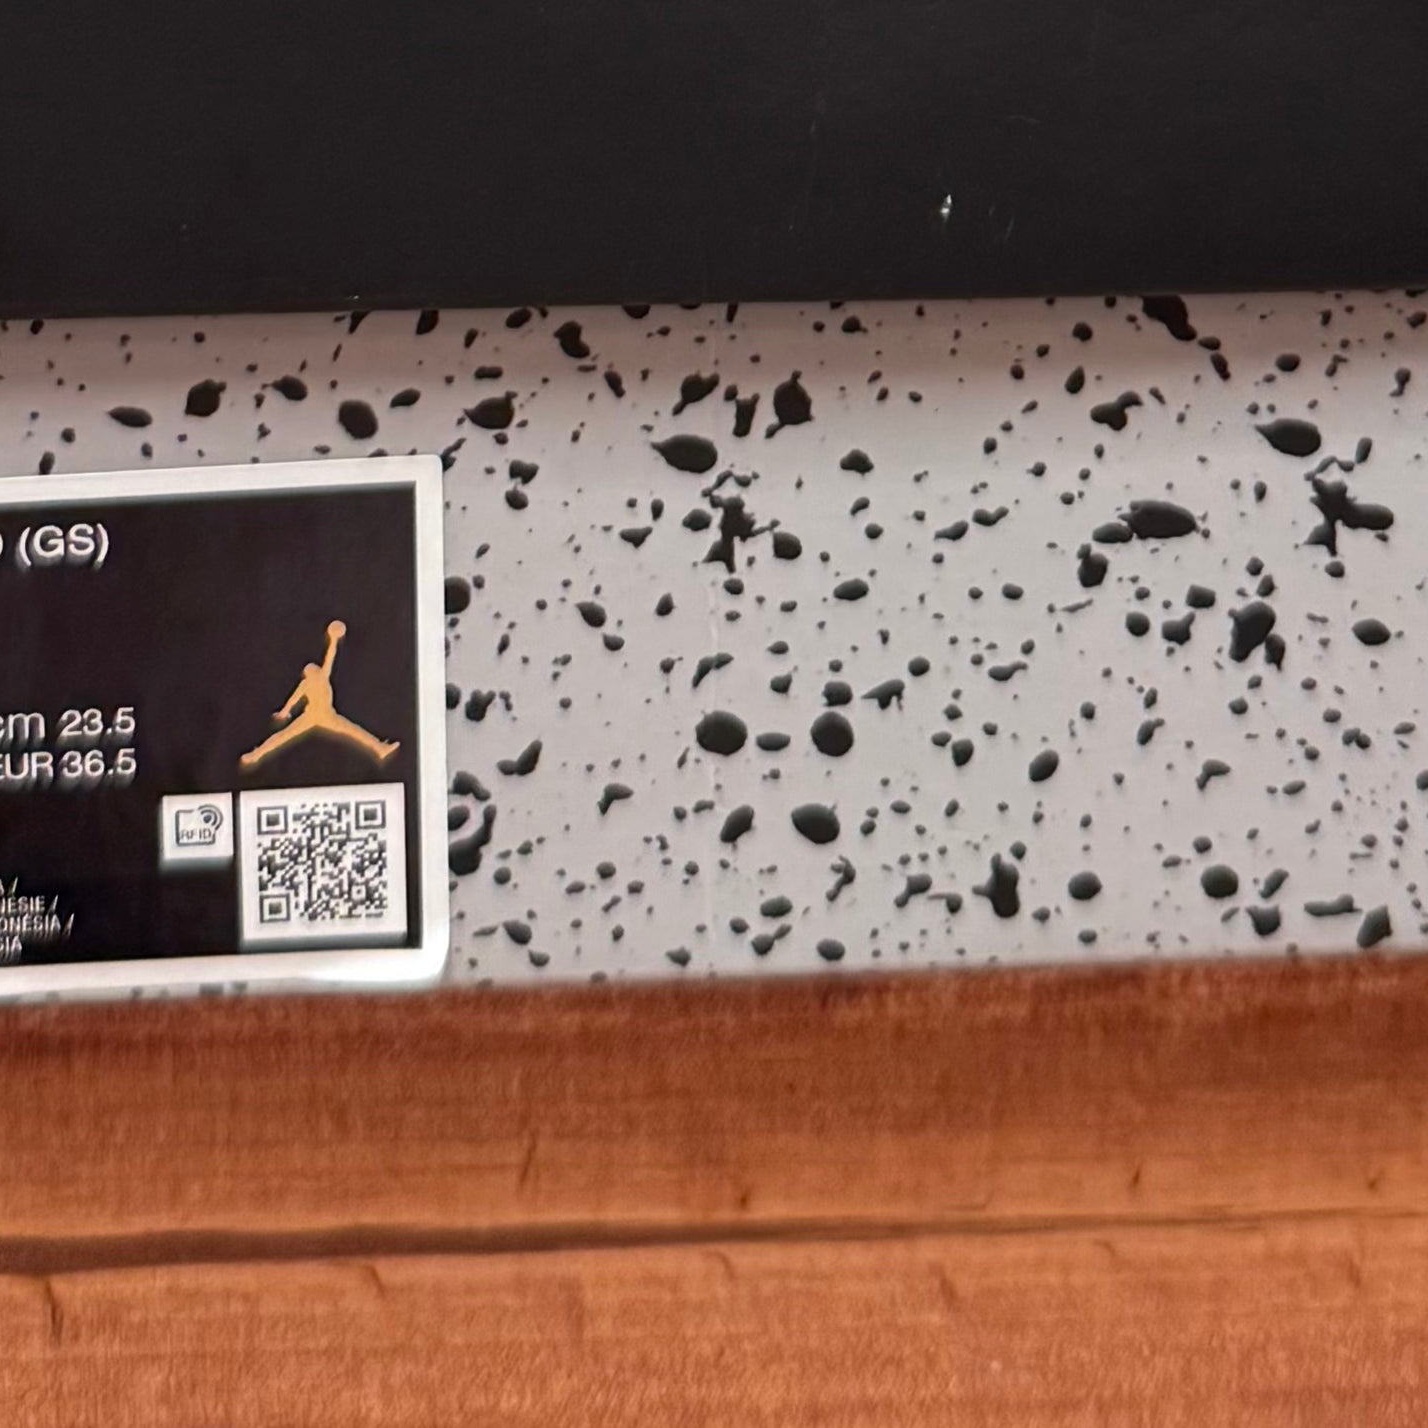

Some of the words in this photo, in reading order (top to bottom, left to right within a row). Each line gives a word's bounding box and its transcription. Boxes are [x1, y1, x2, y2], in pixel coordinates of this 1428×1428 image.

[18, 523, 109, 566] (GS)
[59, 706, 135, 736] 23.5
[61, 747, 137, 776] 36.5
